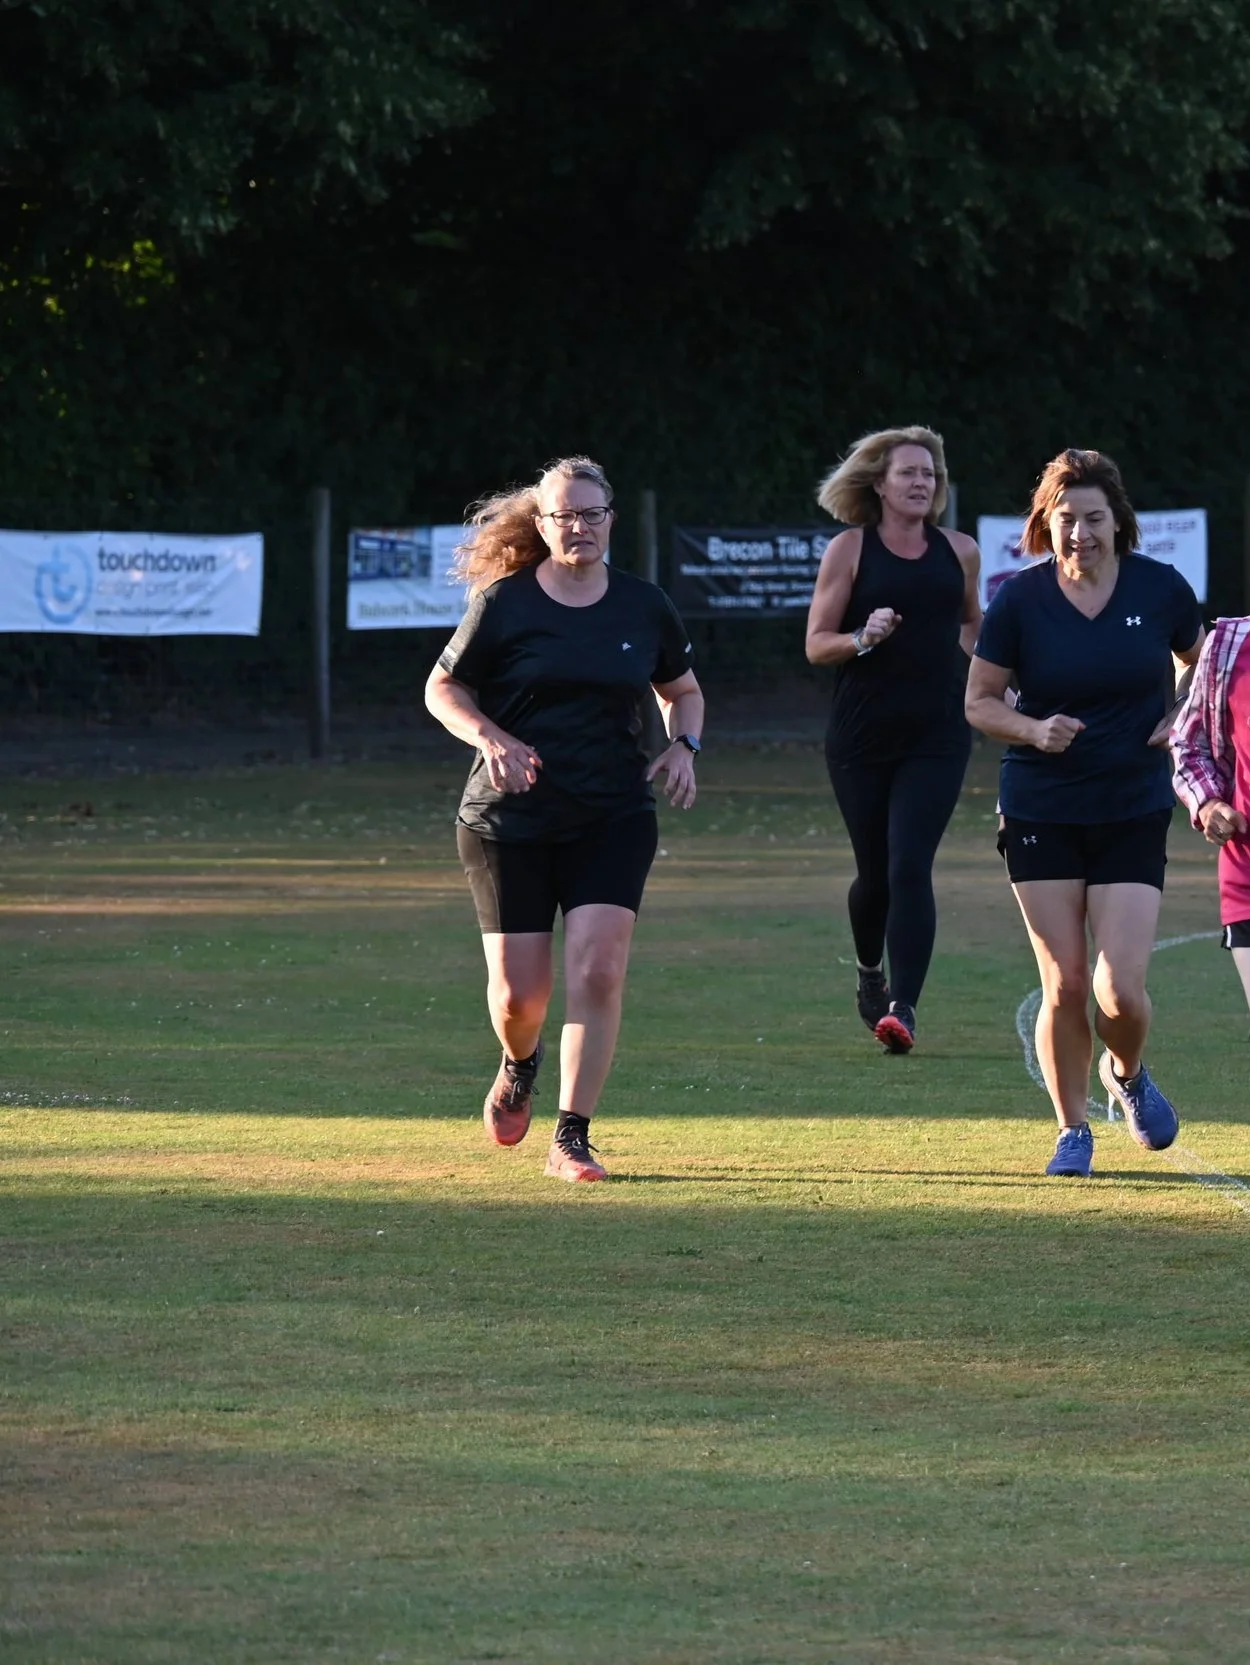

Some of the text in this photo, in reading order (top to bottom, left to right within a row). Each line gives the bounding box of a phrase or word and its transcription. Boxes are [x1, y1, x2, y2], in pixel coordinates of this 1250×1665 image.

[98, 546, 217, 573] touchdown
[707, 536, 774, 560] Brecon
[777, 536, 810, 560] Tile
